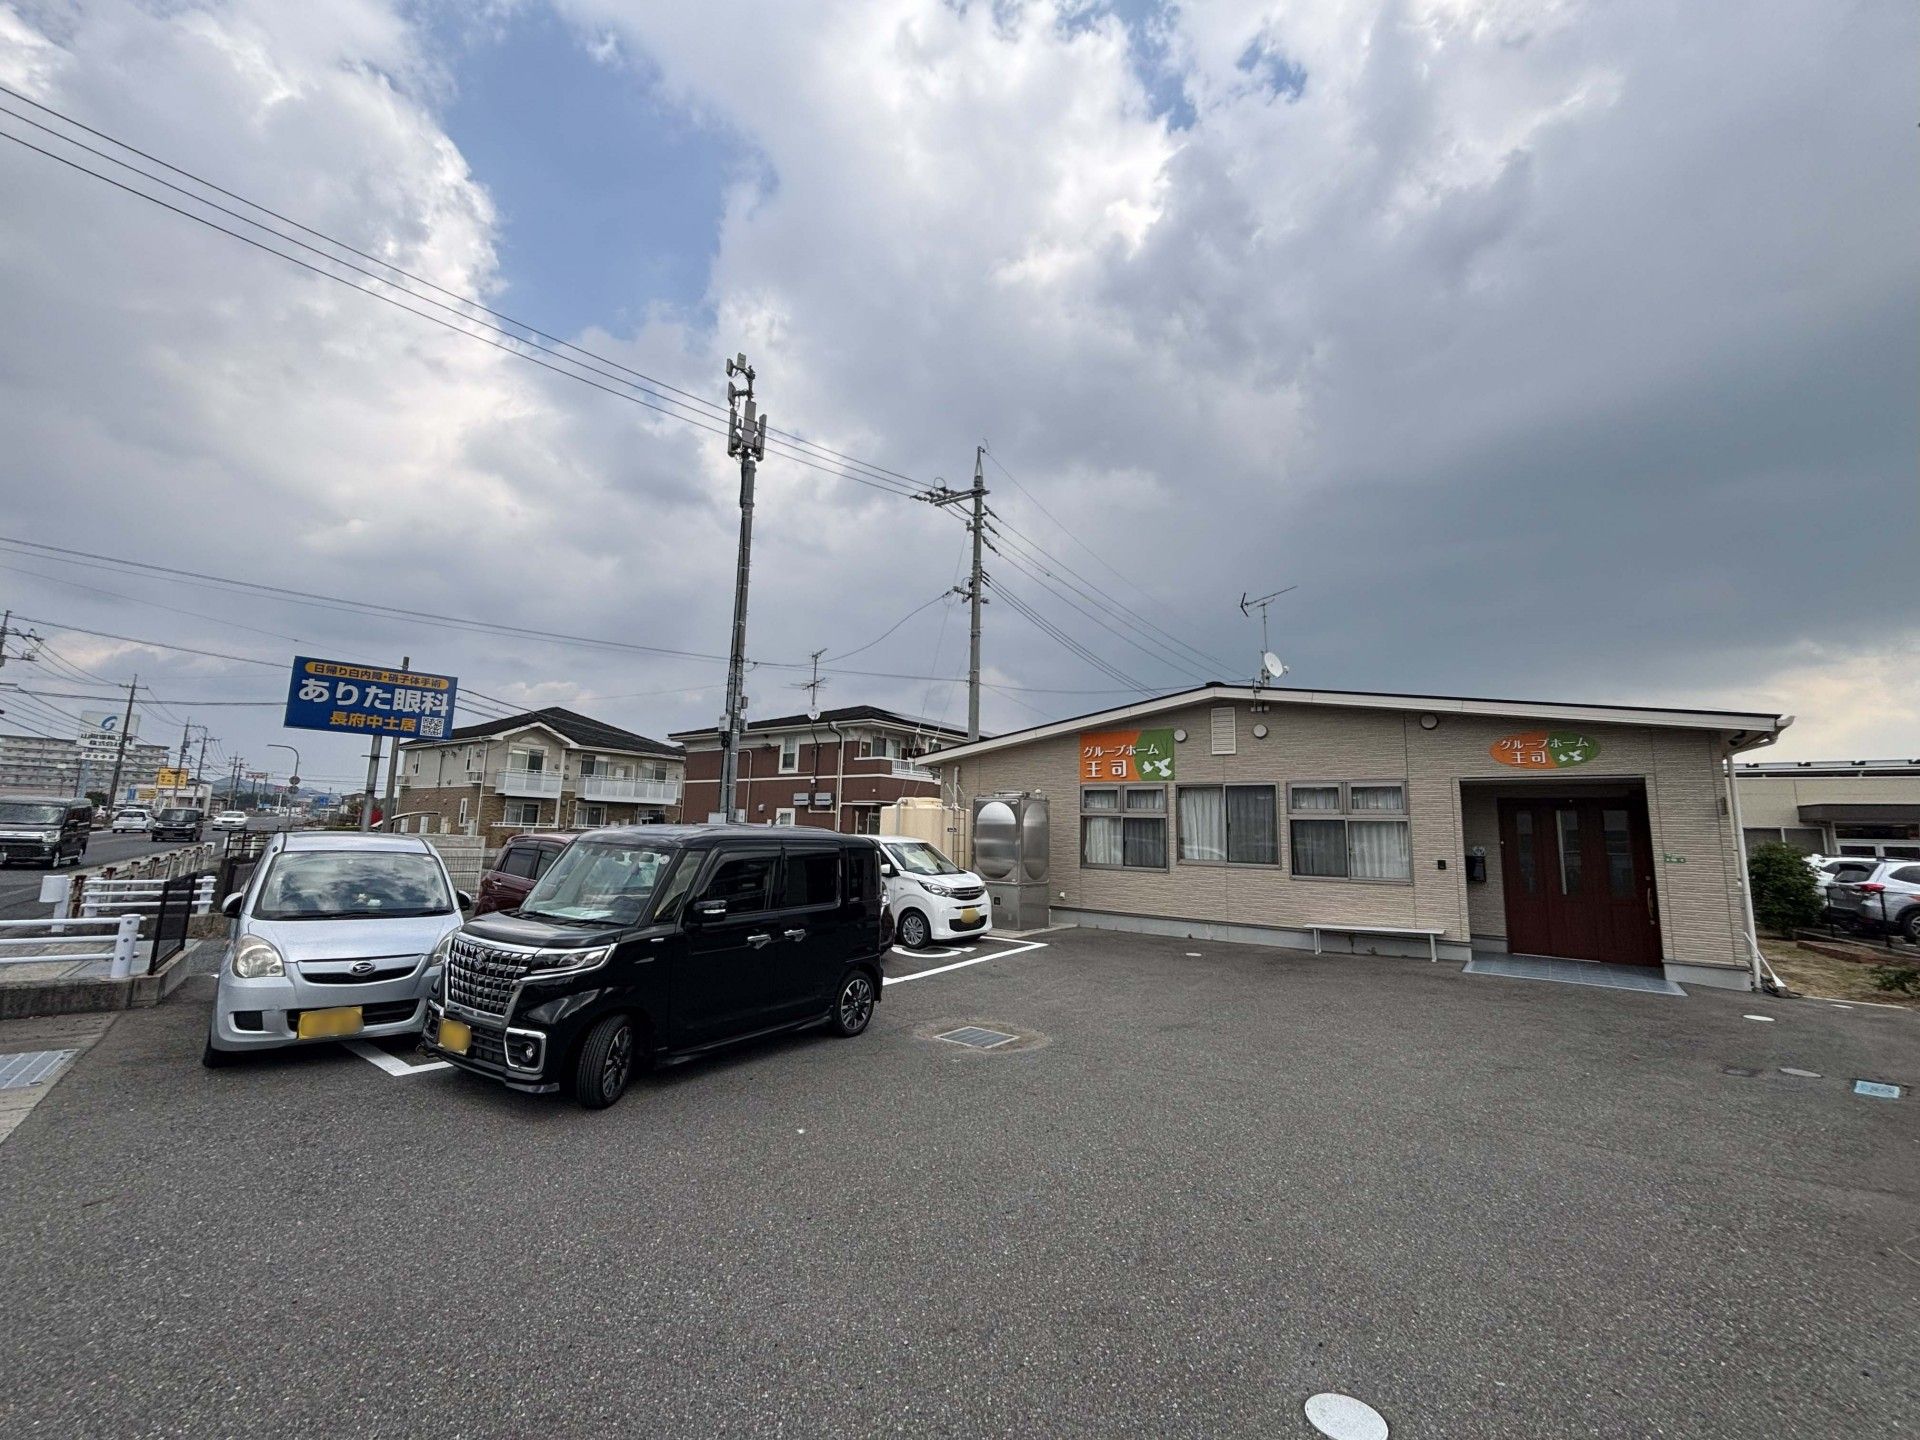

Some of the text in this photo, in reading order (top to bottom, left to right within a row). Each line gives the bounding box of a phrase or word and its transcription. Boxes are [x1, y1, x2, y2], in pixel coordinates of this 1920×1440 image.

[314, 663, 441, 688] 日帰り白内障・硝子体手術
[298, 678, 449, 717] ありた眼科
[329, 711, 417, 732] 長府中土居
[1083, 744, 1159, 758] グループホーム
[1500, 737, 1588, 750] グループホーム
[1512, 751, 1546, 764] 王司
[1085, 759, 1127, 778] 王司
